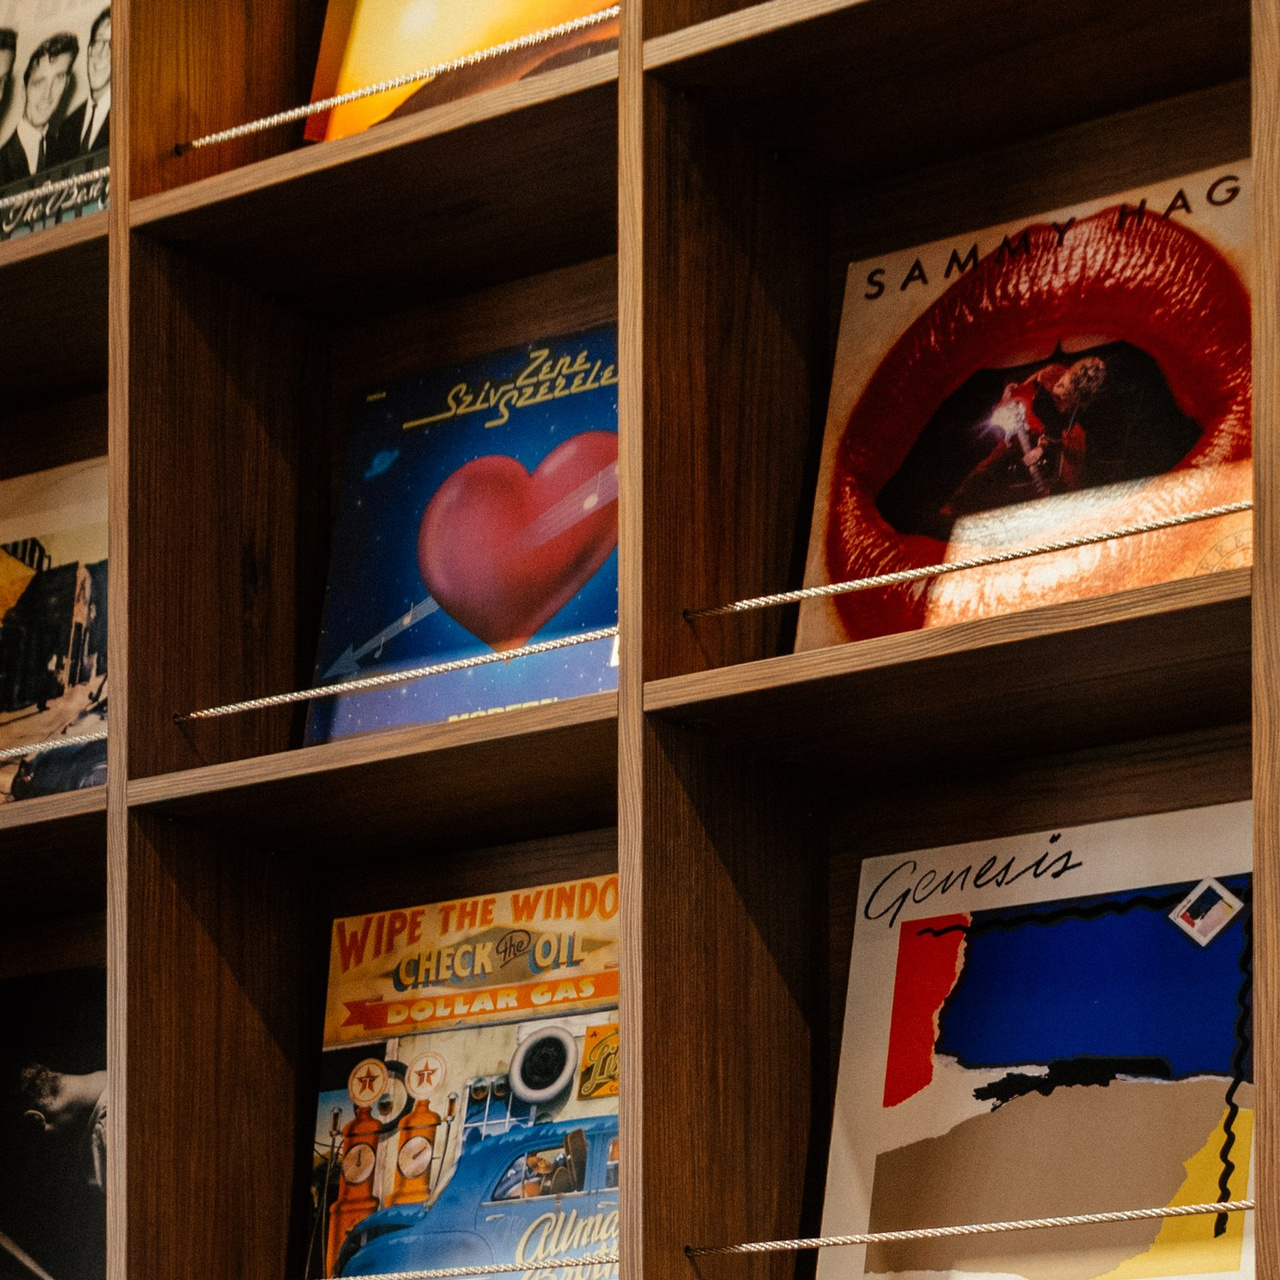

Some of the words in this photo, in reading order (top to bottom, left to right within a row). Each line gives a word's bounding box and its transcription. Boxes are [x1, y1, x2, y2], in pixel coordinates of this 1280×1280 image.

[864, 217, 1075, 301] SAMMY
[1119, 175, 1241, 227] HAG
[336, 909, 426, 975] WIPE
[439, 898, 496, 936] THE
[510, 877, 619, 923] WINDO
[864, 834, 1083, 928] Genesis
[386, 989, 518, 1024] DOLLAR
[530, 978, 595, 1005] GAS
[395, 941, 493, 990] CHECK
[495, 929, 531, 968] the
[531, 930, 590, 972] OIL
